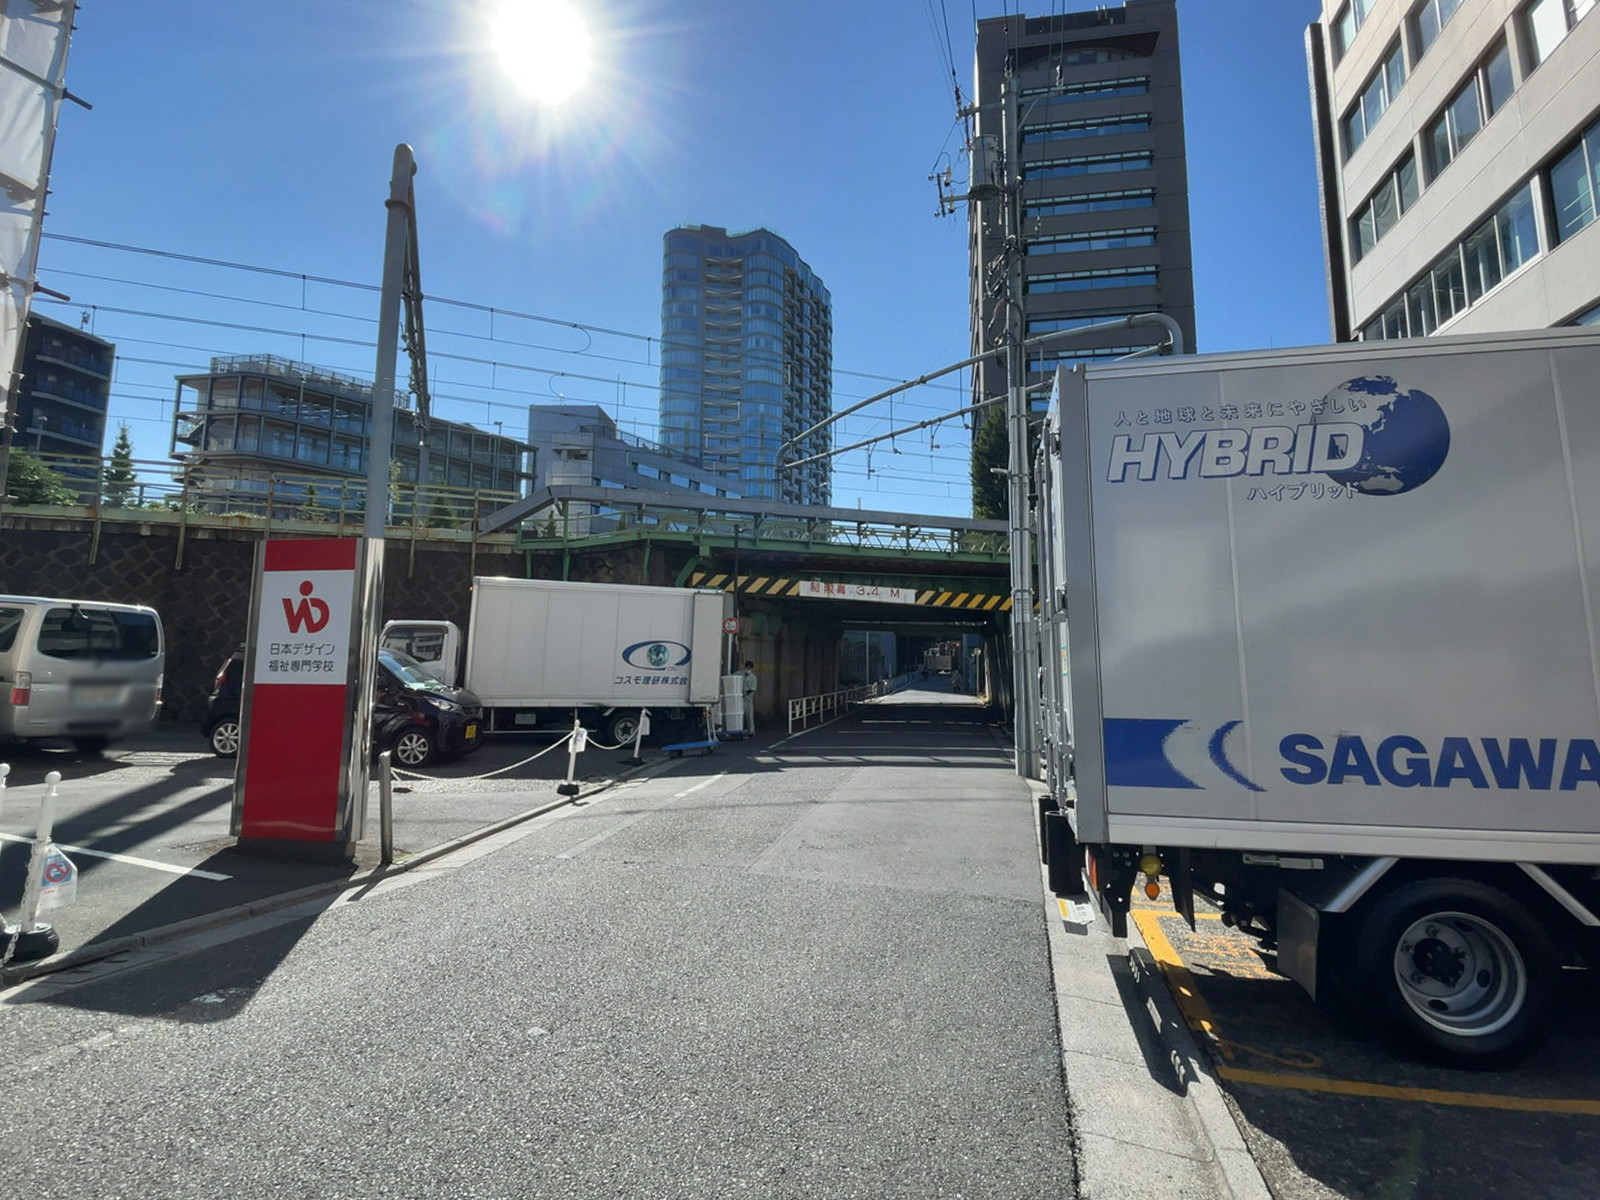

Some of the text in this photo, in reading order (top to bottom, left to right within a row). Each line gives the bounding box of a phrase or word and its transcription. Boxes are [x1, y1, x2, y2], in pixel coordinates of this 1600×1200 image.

[1113, 398, 1368, 427] 人と地球と未来にやさしい
[1106, 421, 1364, 483] HYBRID
[1246, 480, 1360, 501] ハイブリッド
[856, 585, 879, 596] 3.4
[890, 588, 900, 598] M
[269, 642, 336, 657] 日本デザイン
[268, 659, 335, 673] 福祉専門学校
[613, 675, 689, 686] コスモ理研株式会
[1278, 732, 1600, 791] SAGAWA
